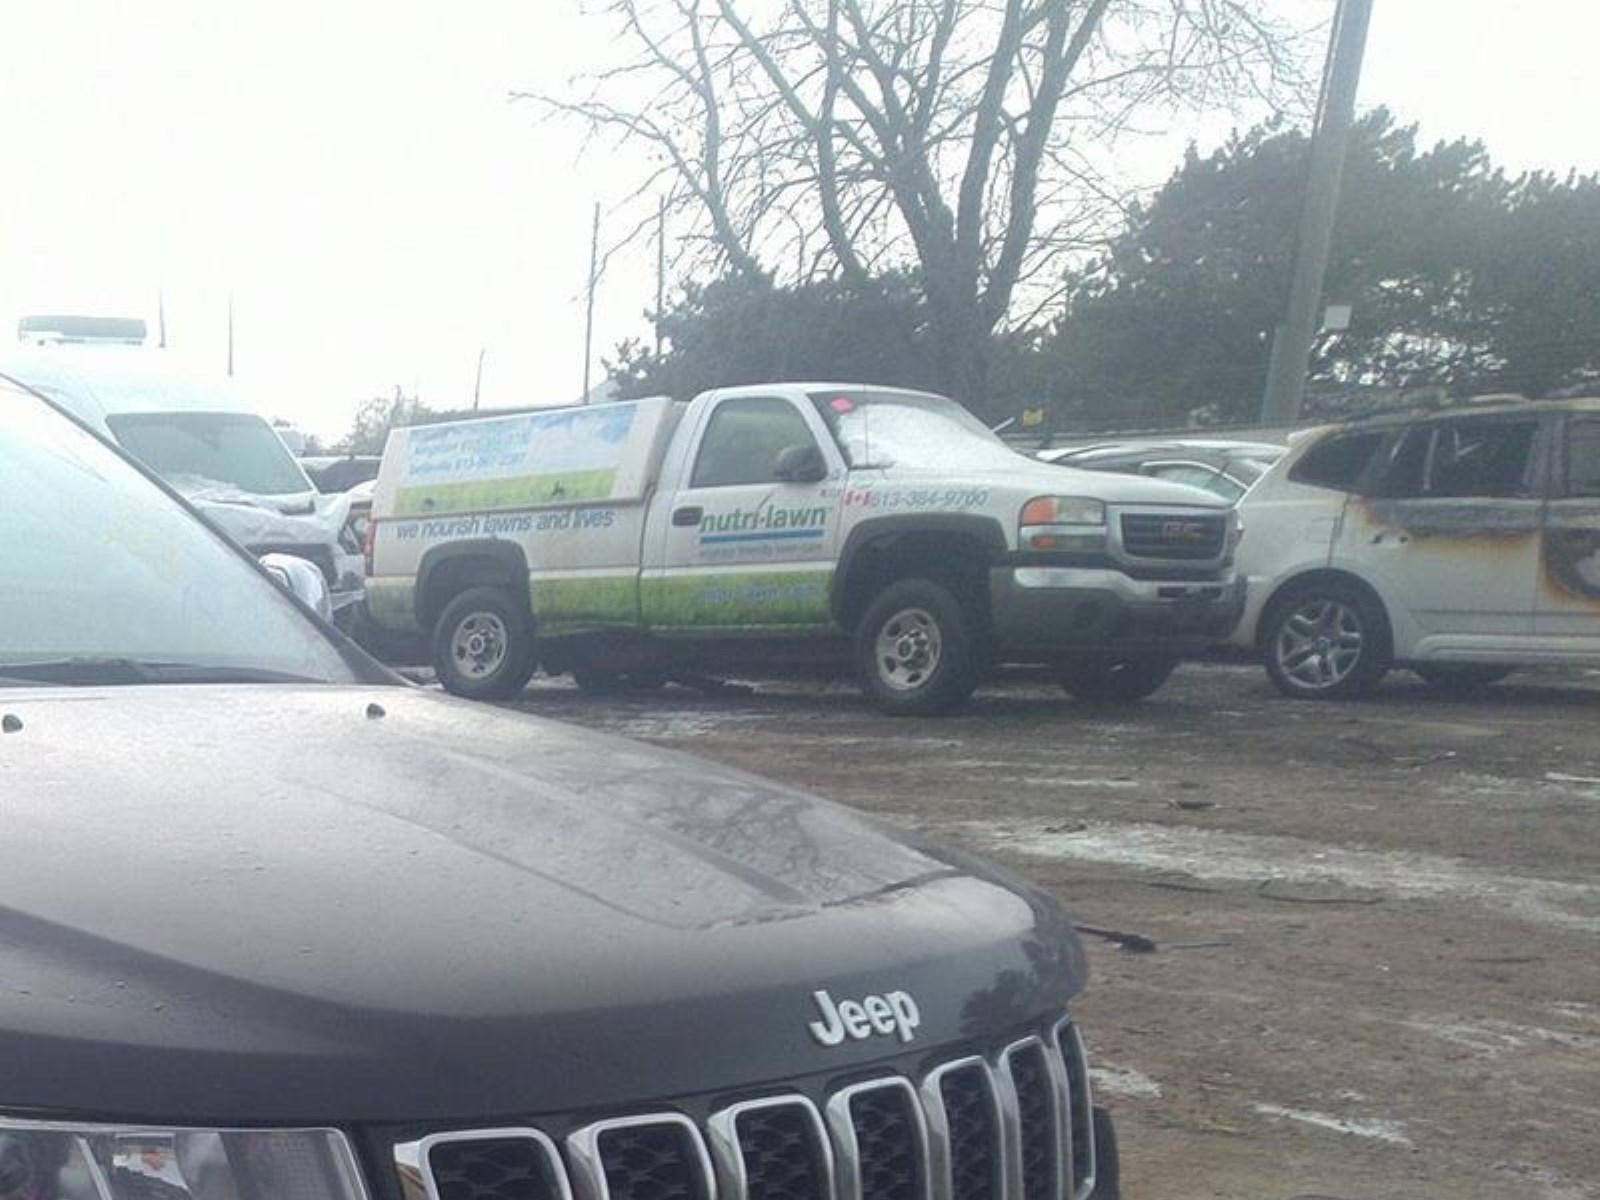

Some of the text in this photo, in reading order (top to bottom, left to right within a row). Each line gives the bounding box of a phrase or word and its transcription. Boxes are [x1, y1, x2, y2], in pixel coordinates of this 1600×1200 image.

[397, 505, 617, 539] we nourish lawns and lives
[808, 990, 921, 1045] Jeep
